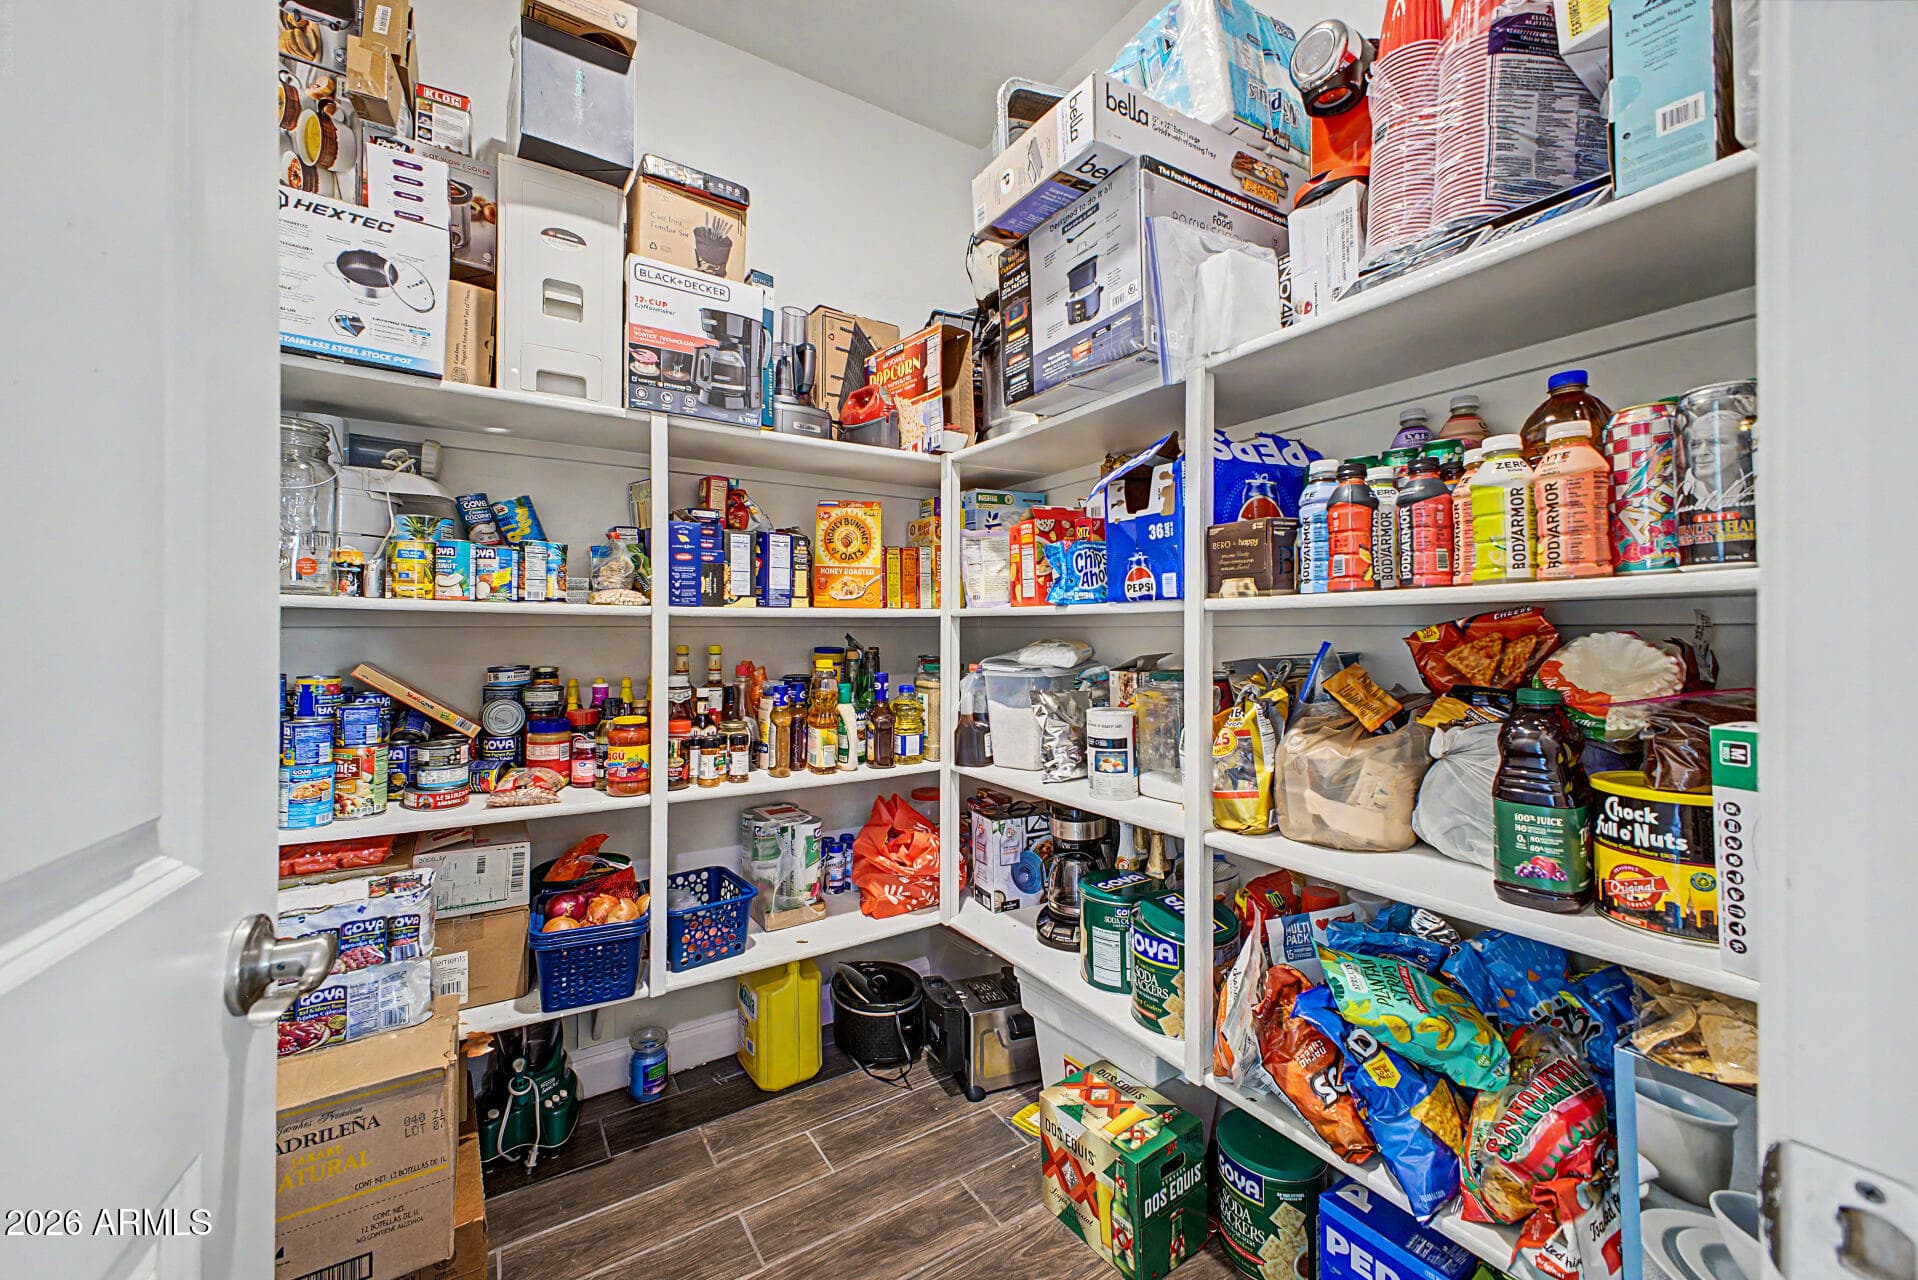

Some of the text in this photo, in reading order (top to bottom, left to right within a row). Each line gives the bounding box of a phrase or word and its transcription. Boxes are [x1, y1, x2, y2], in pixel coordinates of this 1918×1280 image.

[1069, 90, 1084, 142] bella
[1105, 81, 1149, 128] bella
[292, 198, 396, 235] HEXTEC
[1049, 207, 1078, 233] Designed
[1078, 201, 1087, 213] to
[1087, 195, 1097, 207] do
[638, 267, 727, 298] BLACK+DECKER
[359, 348, 392, 362] STOCK
[393, 353, 414, 366] POT
[868, 353, 921, 387] POPCORN
[1214, 432, 1310, 468] PEPS
[1494, 460, 1527, 470] ZERO
[1376, 488, 1398, 496] ERO
[826, 517, 869, 546] HONEY BUNCHES
[1148, 523, 1164, 541] 36
[1510, 486, 1526, 570] BODYARMOR
[1544, 480, 1559, 570] BODYARMOR
[839, 548, 865, 561] OATS
[1300, 515, 1313, 585] BODYARMOR
[1380, 510, 1393, 582] BODYARMOR
[1399, 505, 1411, 580] BODYARMOR
[820, 567, 876, 576] HONEY ROASTED
[1074, 549, 1107, 574] Chips
[1081, 568, 1107, 589] Aho
[1126, 581, 1155, 594] PEPSI
[1514, 812, 1565, 828] 100% JUICE
[1595, 812, 1619, 838] full
[1604, 795, 1661, 826] Chock
[1514, 823, 1528, 833] NO
[1097, 872, 1145, 892] GOYA
[1610, 878, 1656, 895] Original
[344, 918, 386, 936] GOYA
[1285, 922, 1311, 936] MULTI
[1286, 931, 1313, 946] PACK
[299, 988, 346, 1007] GOYA
[1096, 1068, 1147, 1100] DOS EQUIS
[276, 1114, 382, 1157] ADRILEÑA
[404, 1124, 426, 1139] LOT
[1045, 1117, 1096, 1167] DOS EQUIS
[278, 1150, 371, 1195] ATURAL
[1219, 1153, 1260, 1200] GOYA
[1144, 1161, 1203, 1219] DOS EQUIS
[1222, 1188, 1253, 1224] SODA
[1325, 1224, 1401, 1280] PEP
